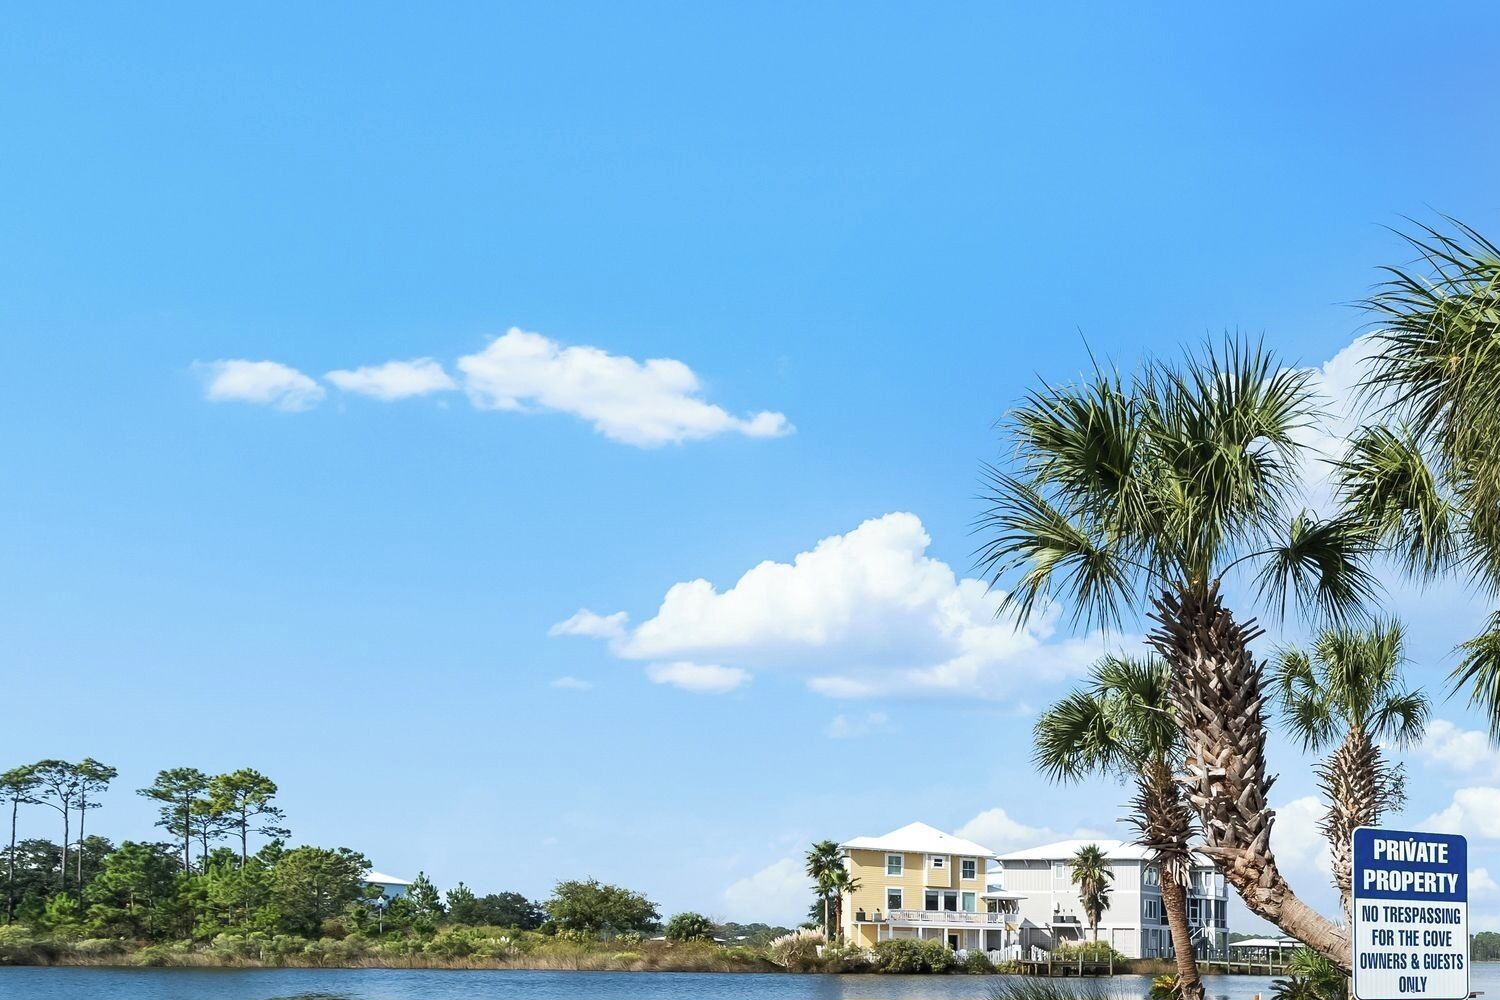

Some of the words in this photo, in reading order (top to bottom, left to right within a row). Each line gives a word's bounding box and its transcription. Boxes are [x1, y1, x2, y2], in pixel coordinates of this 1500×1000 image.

[1374, 839, 1448, 863] PRIVATE
[1363, 869, 1458, 893] PROPERTY
[1362, 905, 1379, 922] NO
[1383, 906, 1461, 924] TRESPASSING
[1372, 929, 1394, 946] FOR
[1398, 930, 1419, 946] THE
[1423, 930, 1452, 947] COVE
[1360, 952, 1407, 969] OWNERS
[1411, 953, 1420, 969] &
[1424, 953, 1464, 970] GUESTS
[1399, 976, 1427, 993] ONLY
